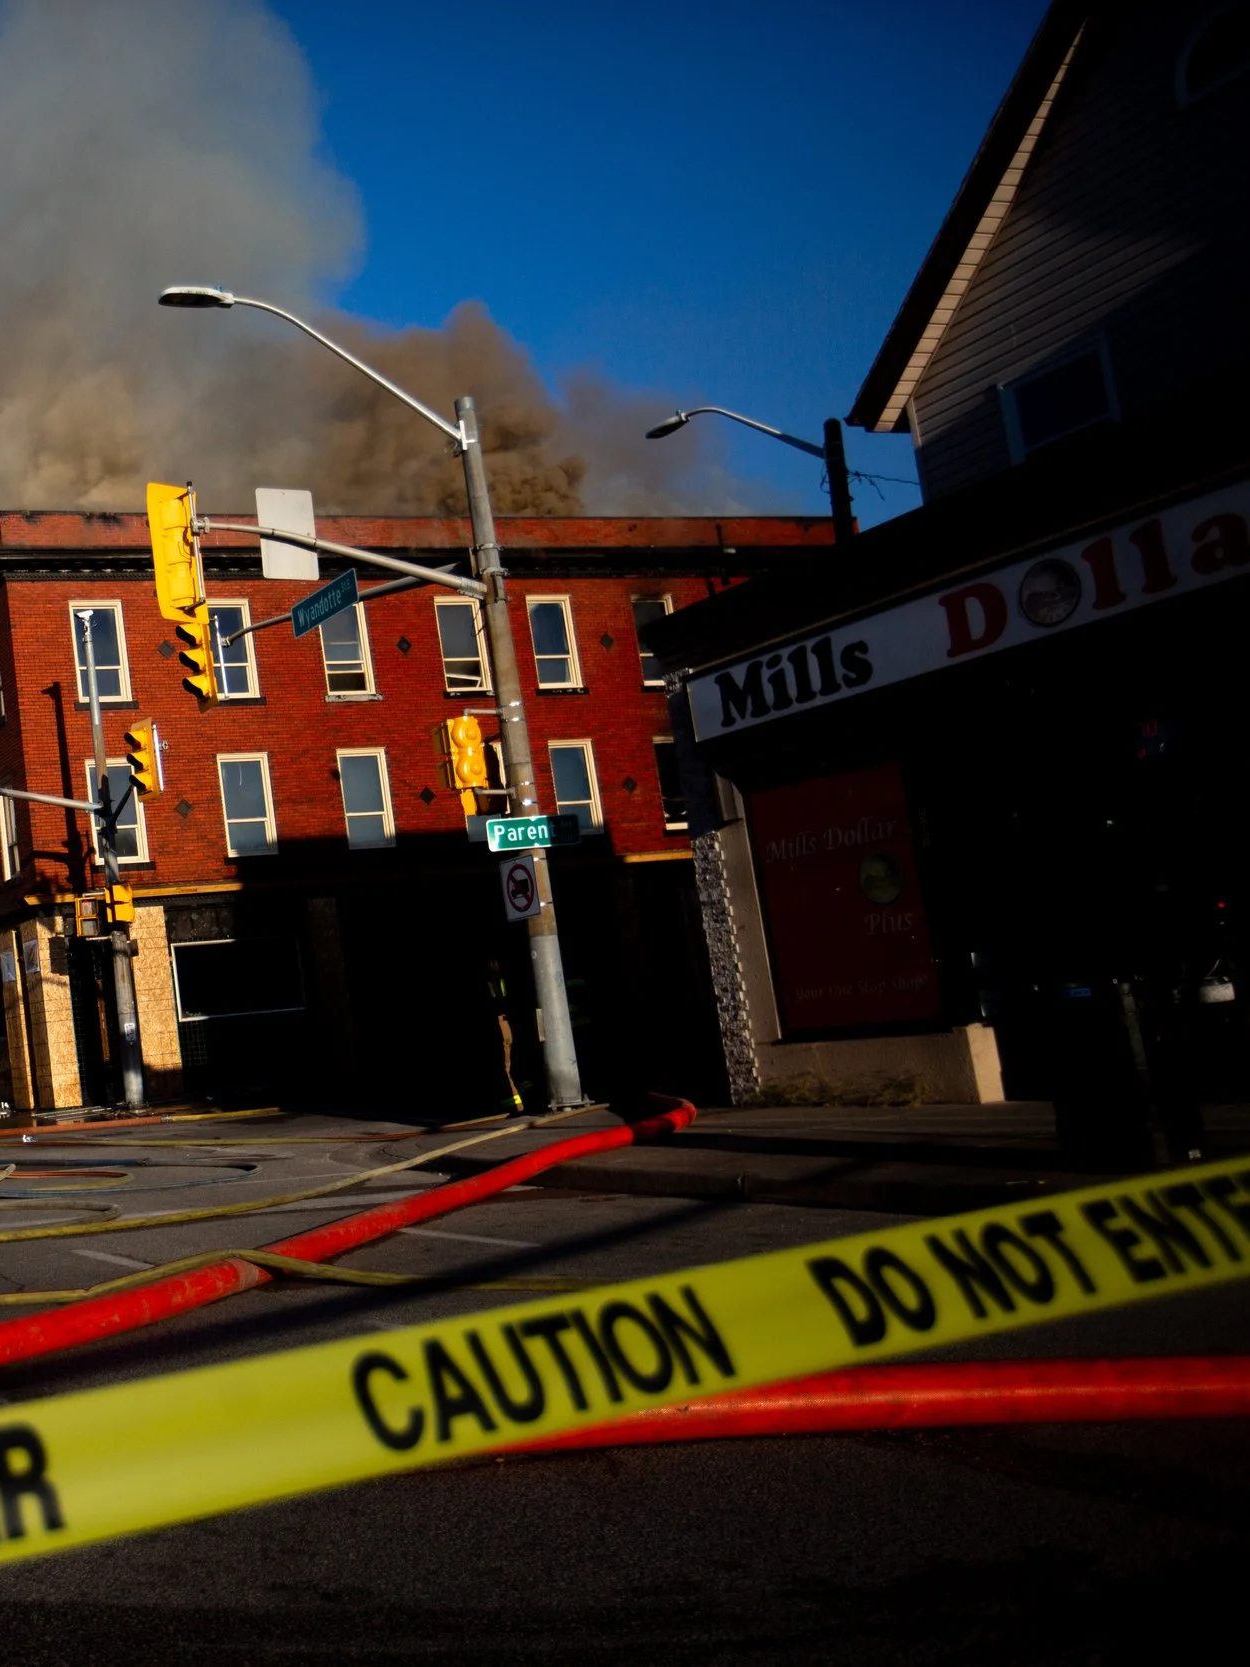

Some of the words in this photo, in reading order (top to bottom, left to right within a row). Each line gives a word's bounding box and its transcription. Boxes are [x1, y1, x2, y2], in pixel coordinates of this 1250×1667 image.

[297, 590, 342, 628] Wyandotte
[715, 636, 873, 727] Mills
[493, 823, 558, 843] Parent
[765, 830, 818, 863] Mills
[822, 815, 899, 851] Dollar
[863, 907, 914, 936] Plus
[352, 1284, 736, 1452] CAUTION
[804, 1246, 937, 1347] DO
[923, 1210, 1097, 1320] NOT
[1077, 1172, 1250, 1283] ENTE
